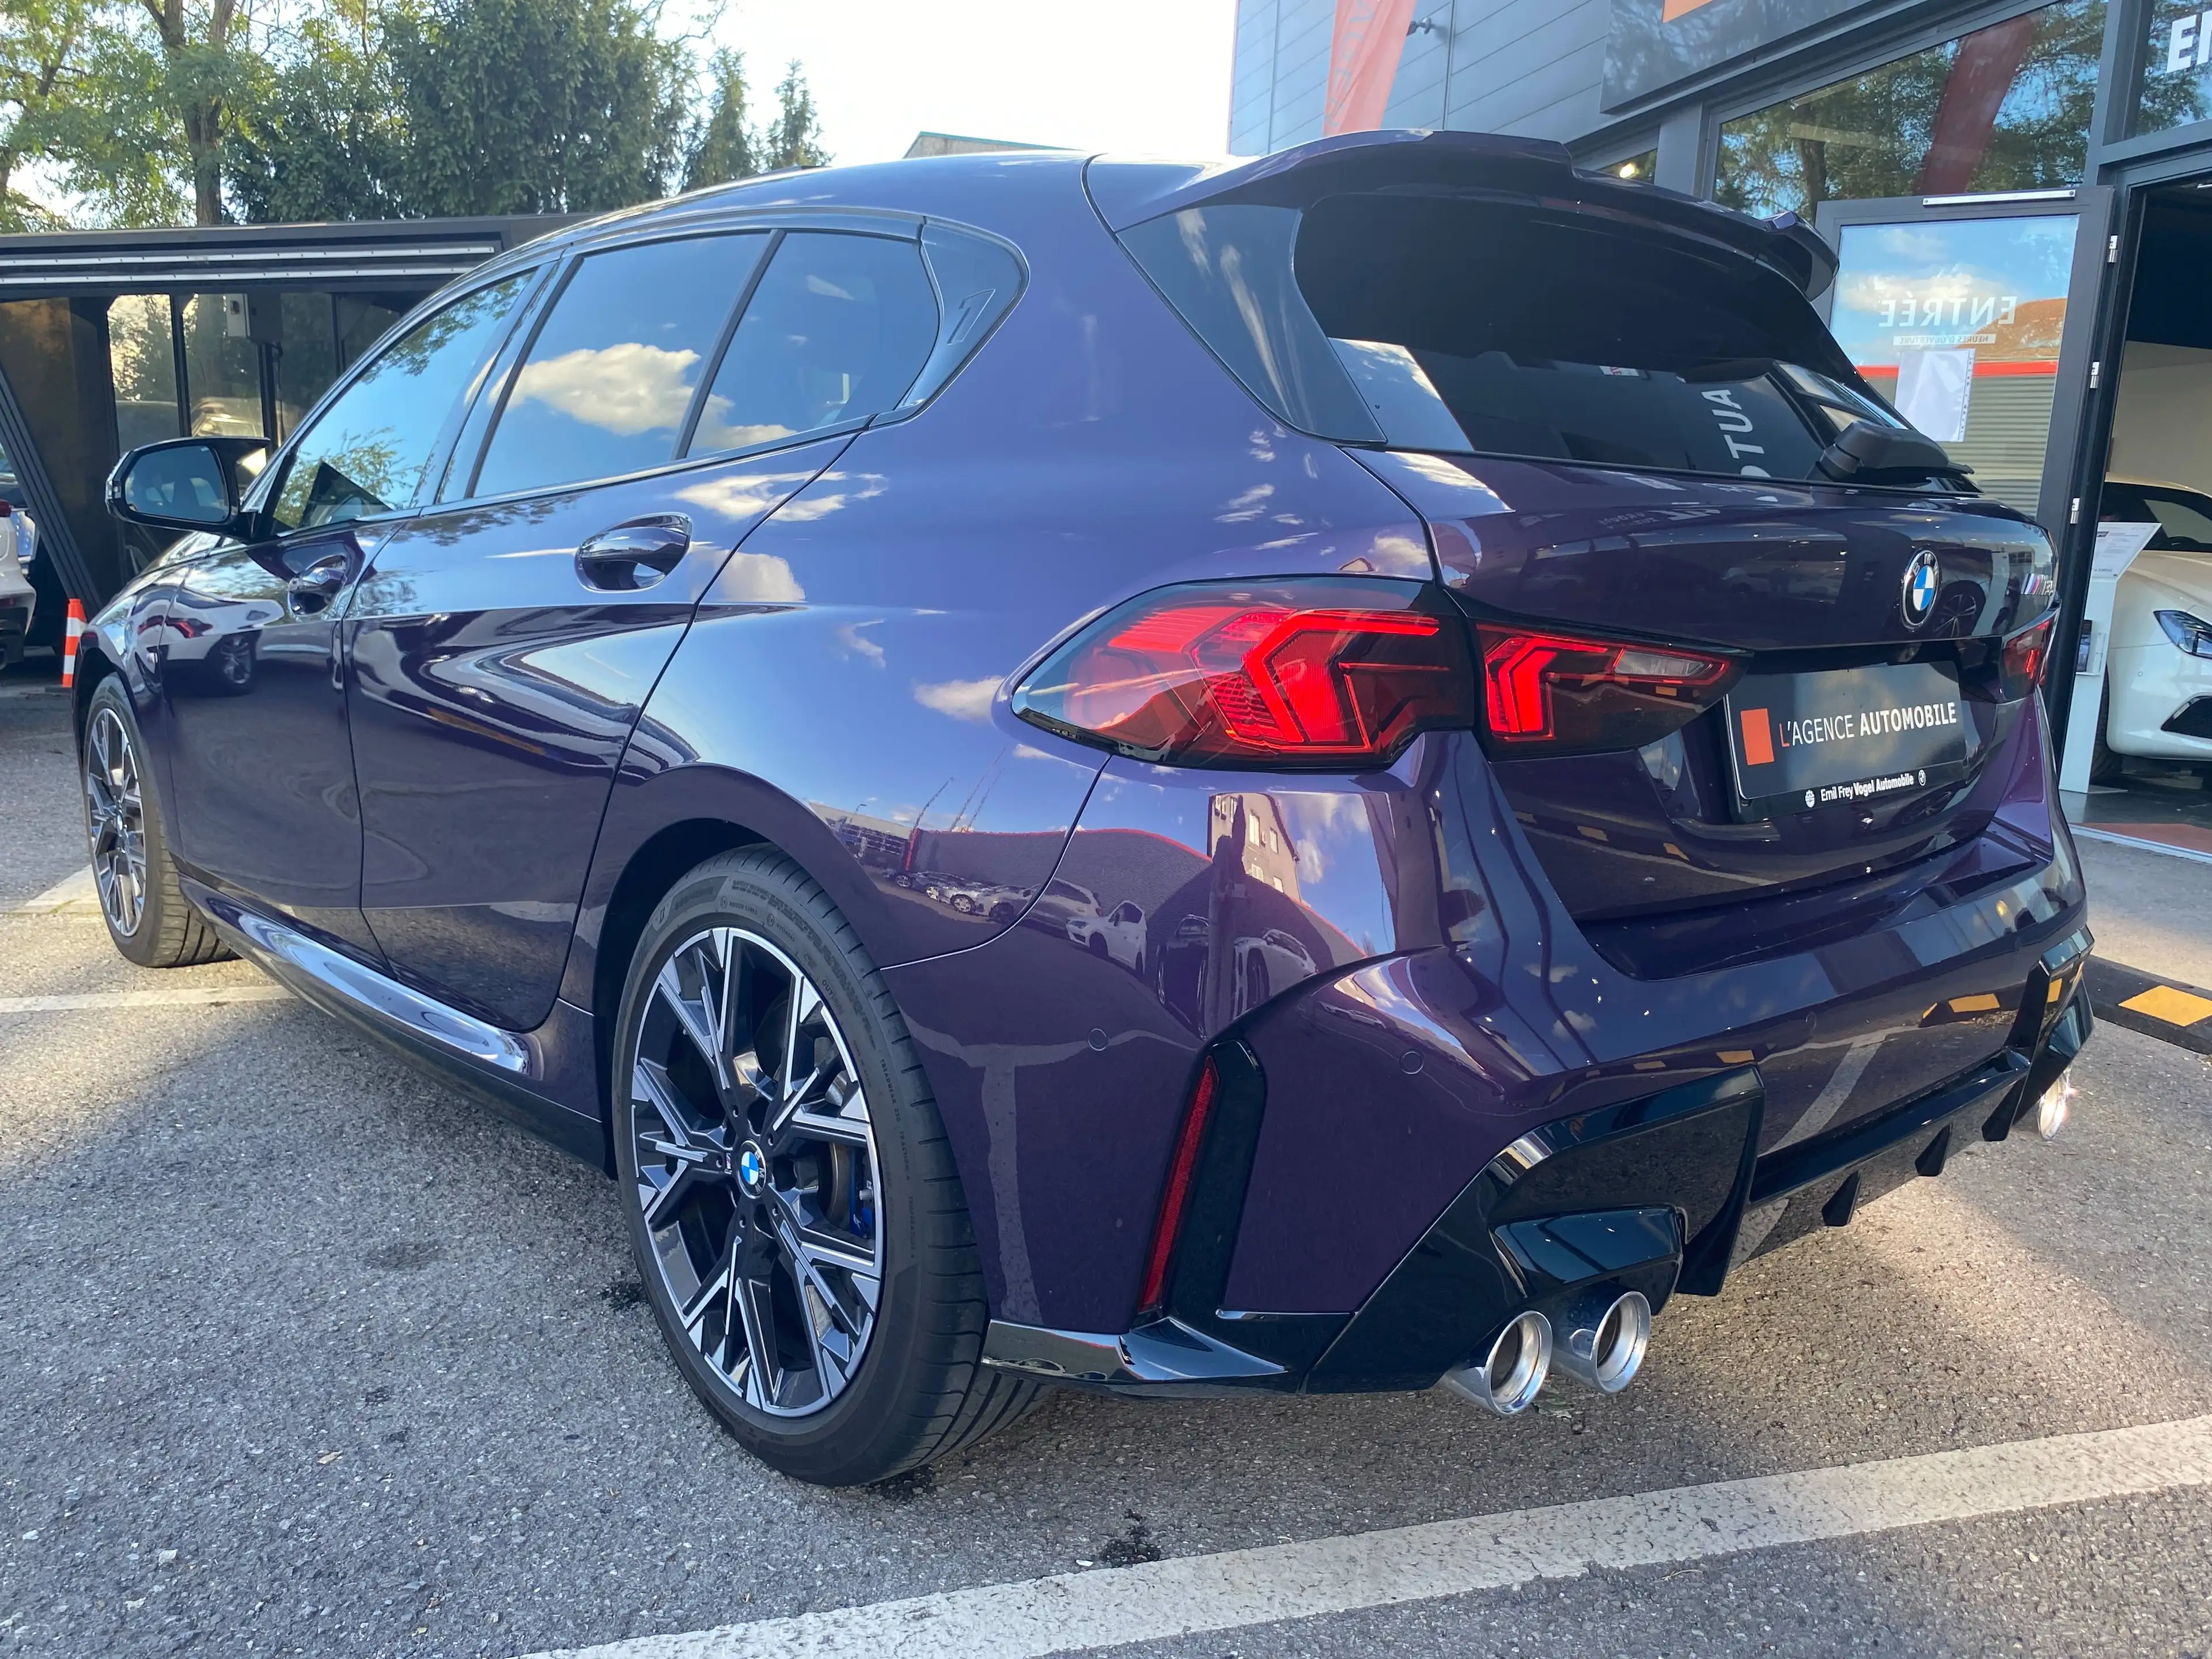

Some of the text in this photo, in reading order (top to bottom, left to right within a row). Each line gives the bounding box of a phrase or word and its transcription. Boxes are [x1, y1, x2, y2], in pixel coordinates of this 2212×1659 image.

[1779, 701, 1957, 748] L'AGENCE AUTOMOBILE
[1820, 786, 1838, 802] Emil
[1838, 786, 1854, 800] Frey
[1853, 779, 1875, 797] Vogel
[1876, 772, 1914, 792] Automobile
[880, 1059, 897, 1104] TREADWEAR
